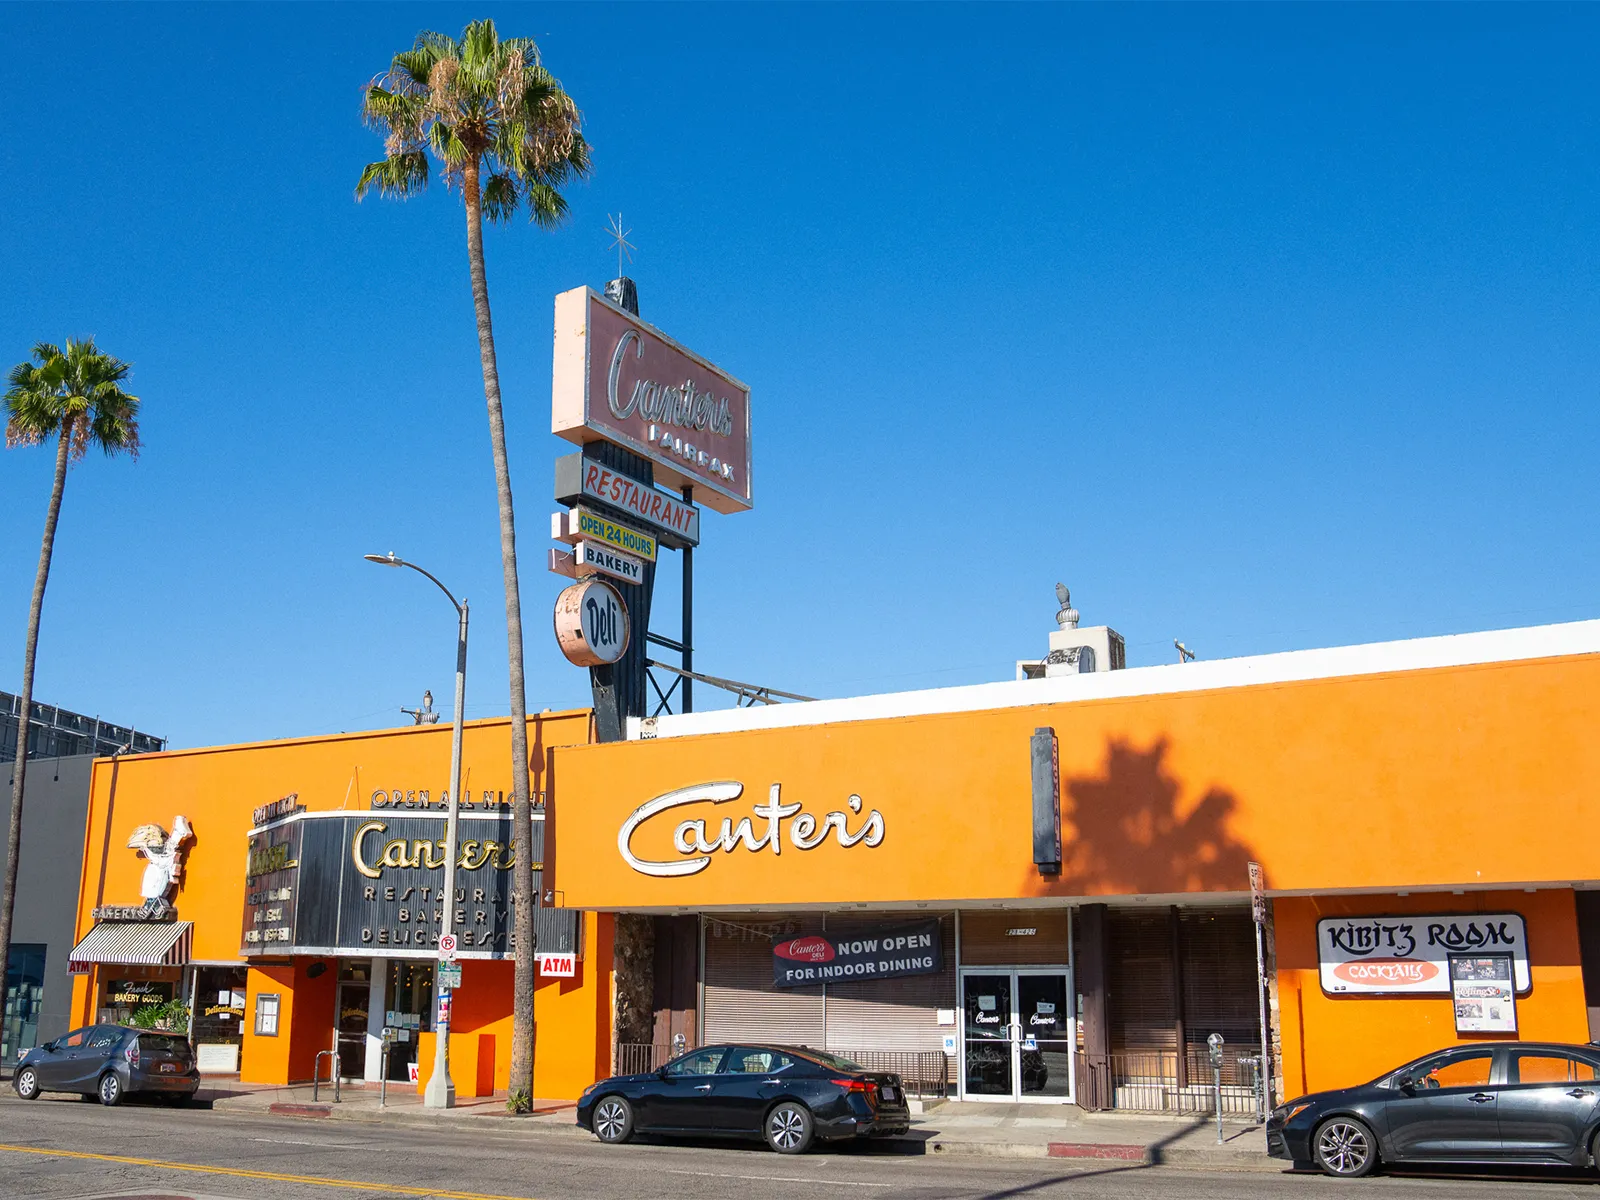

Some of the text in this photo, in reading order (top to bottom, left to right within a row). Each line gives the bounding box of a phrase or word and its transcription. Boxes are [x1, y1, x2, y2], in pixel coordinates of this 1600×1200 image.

[648, 424, 735, 482] FAIRFAX
[585, 465, 697, 533] RESTAURANT
[580, 515, 652, 555] OPEN 24 HOURS
[586, 547, 639, 577] BAKERY
[586, 594, 617, 648] Deli
[372, 789, 430, 808] OPEN
[437, 789, 474, 809] AL
[618, 780, 886, 878] Canter's
[91, 906, 137, 920] BAKERY
[398, 908, 509, 925] BAKERY
[838, 933, 931, 956] NOW OPEN
[1427, 921, 1515, 951] ROOM
[69, 962, 90, 973] ATM
[543, 958, 572, 973] ATM
[786, 956, 933, 981] FOR INDOOR DINING
[1348, 963, 1424, 981] COCKTAILS
[114, 994, 163, 1003] BAKERY GOODS
[123, 981, 155, 995] Fresh
